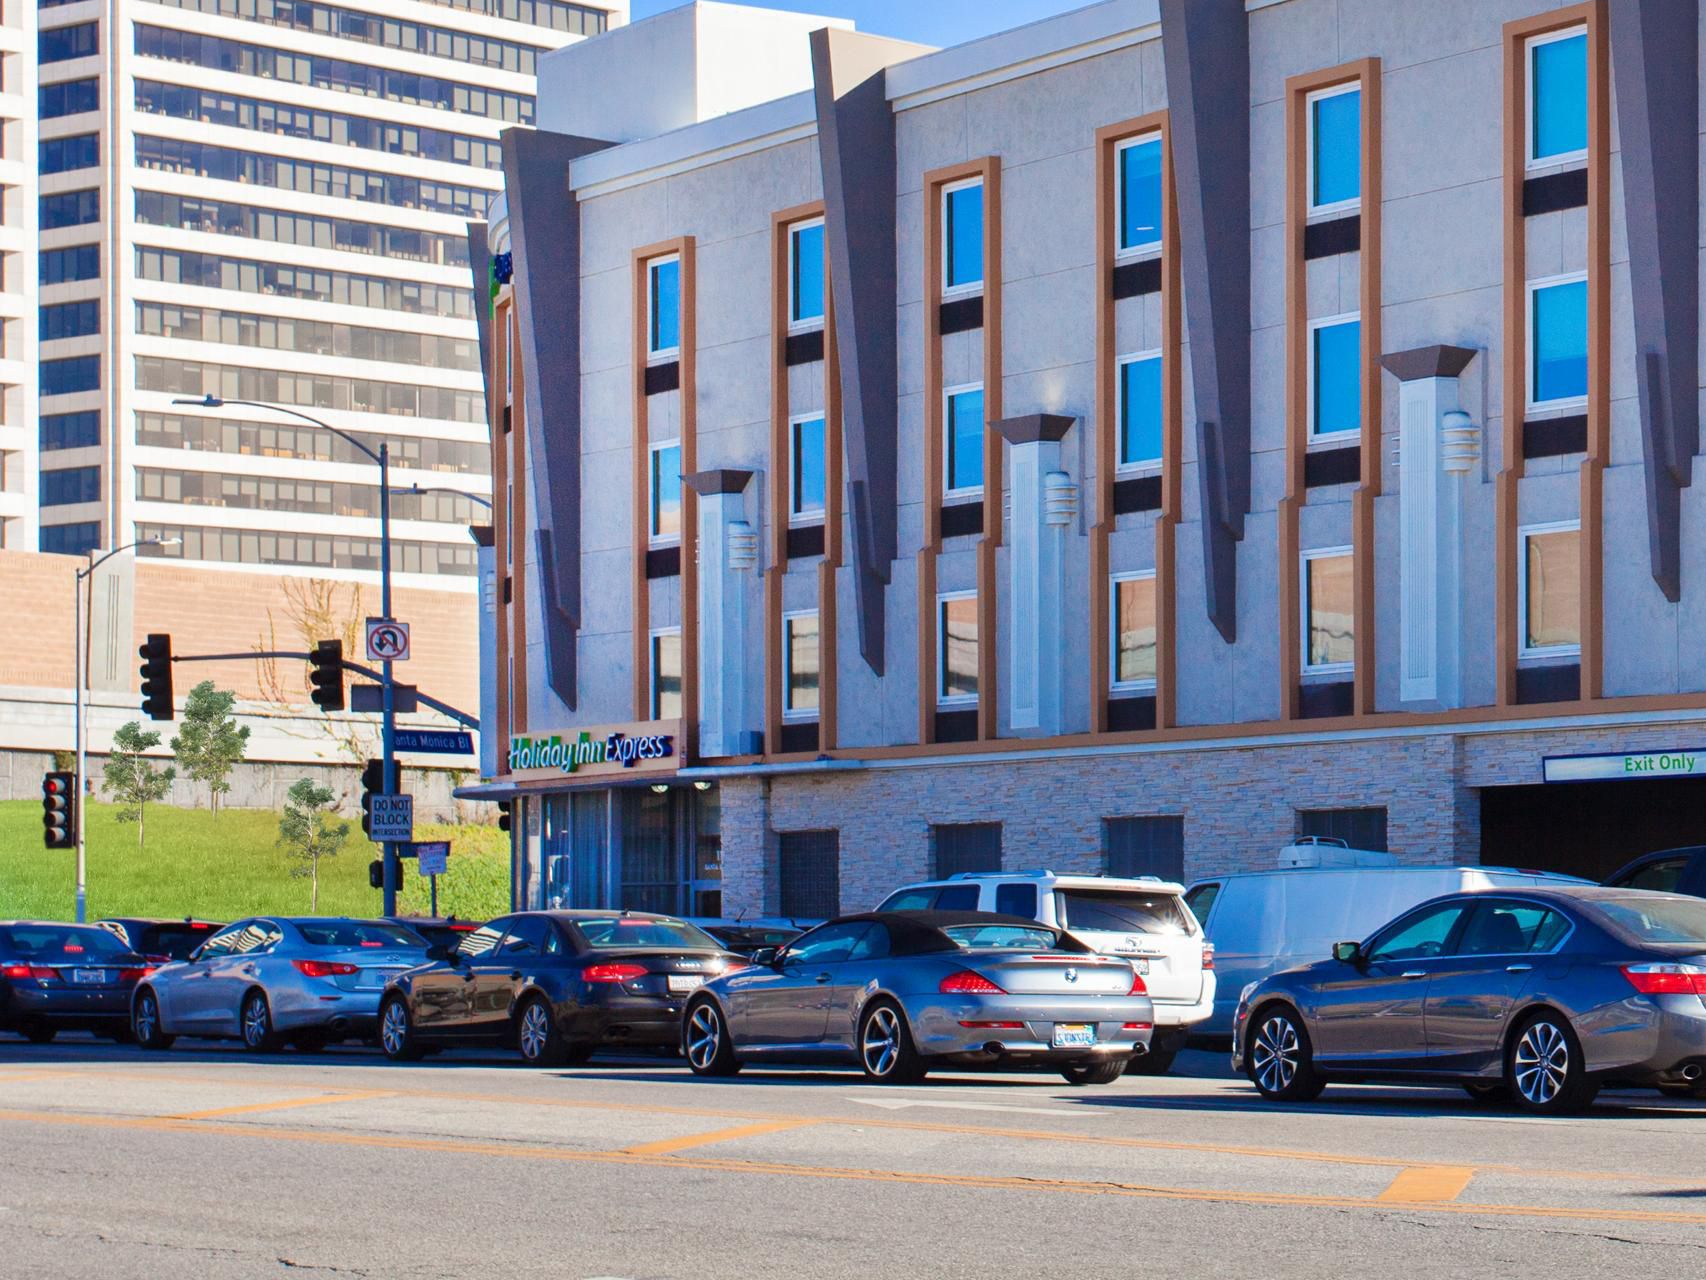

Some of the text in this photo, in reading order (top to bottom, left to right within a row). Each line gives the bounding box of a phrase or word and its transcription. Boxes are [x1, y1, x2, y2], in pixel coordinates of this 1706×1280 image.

[393, 734, 417, 747] anta
[420, 735, 455, 748] Monica
[508, 732, 673, 773] Holiday Inn Express
[1624, 753, 1695, 772] Exit Only
[374, 800, 410, 811] DO NOT
[374, 814, 409, 825] BLOCK
